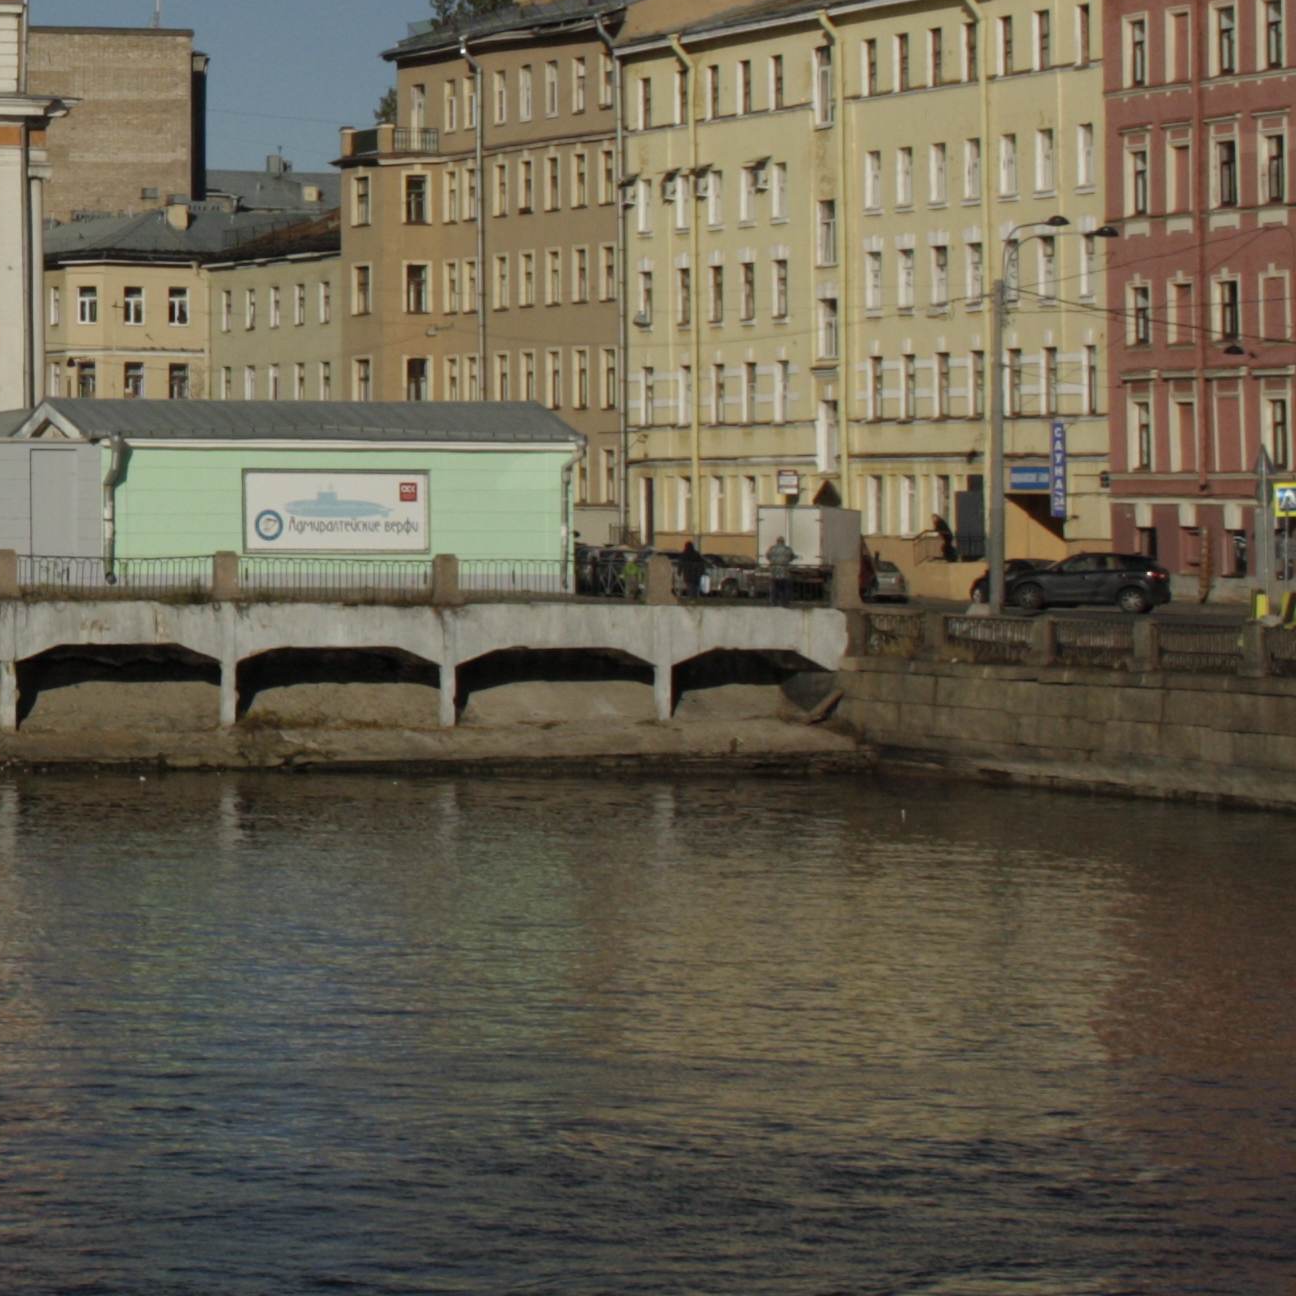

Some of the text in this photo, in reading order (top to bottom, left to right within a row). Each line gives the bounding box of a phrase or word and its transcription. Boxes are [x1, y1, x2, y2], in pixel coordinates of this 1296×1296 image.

[1054, 427, 1063, 490] САУНА
[288, 516, 418, 535] Адмиралтейские верфи
